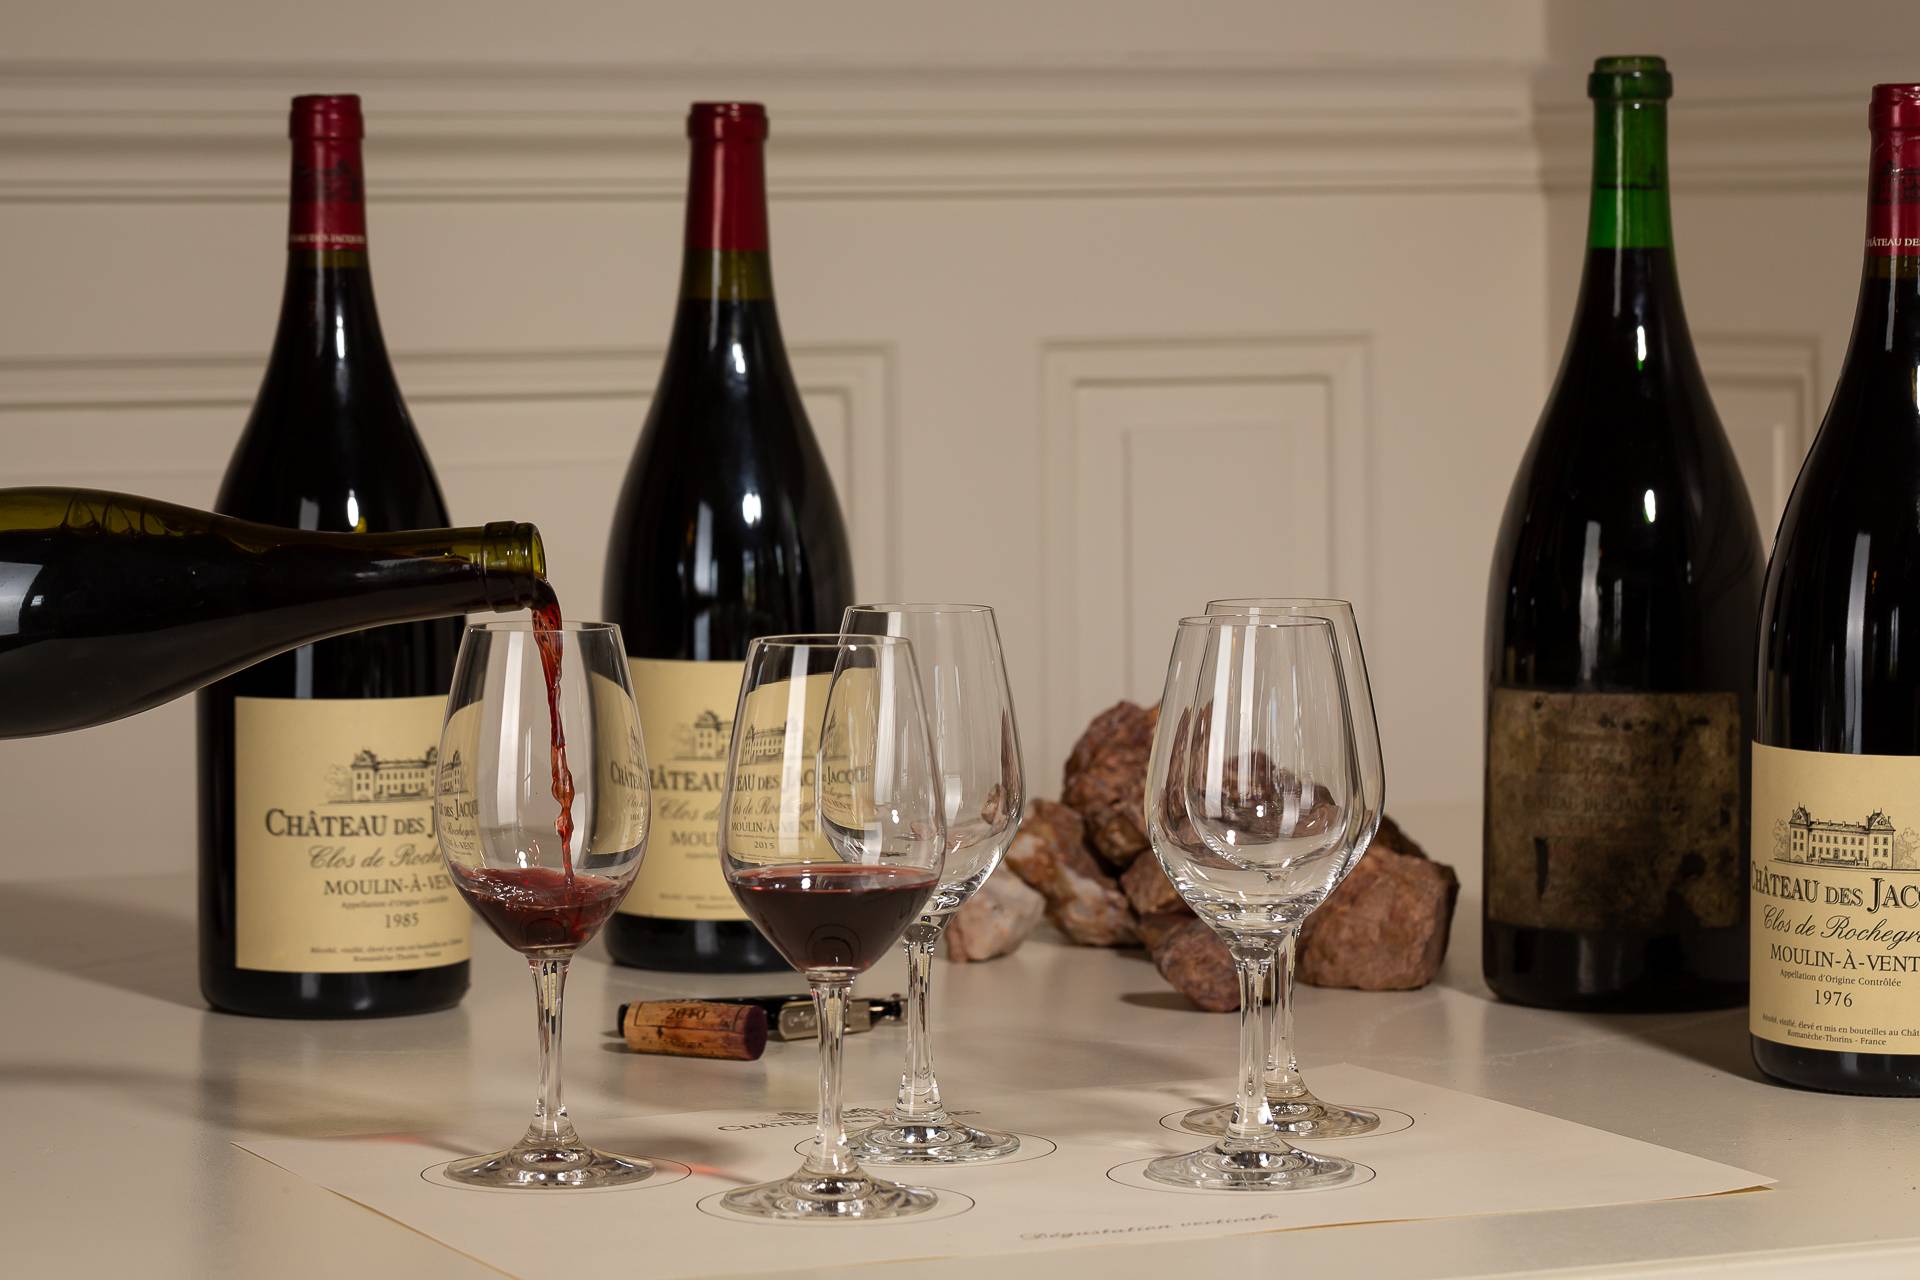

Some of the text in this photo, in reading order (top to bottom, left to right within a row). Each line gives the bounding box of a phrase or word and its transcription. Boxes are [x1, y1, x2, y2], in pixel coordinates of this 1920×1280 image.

[264, 807, 388, 837] CHÂTEAU
[393, 818, 425, 836] DES
[307, 845, 356, 869] Clos
[361, 846, 385, 868] de
[1751, 860, 1920, 914] CHÂTEAU DES JAC
[384, 911, 420, 929] 1985
[1763, 903, 1791, 934] Clos
[1794, 914, 1817, 937] de
[1770, 943, 1920, 973] MOULIN-À-VENT
[1779, 968, 1902, 988] Appellation d'Origine Contrôlée
[1814, 988, 1853, 1008] 1976
[1799, 1020, 1814, 1030] élevé
[1815, 1023, 1823, 1031] et
[1824, 1025, 1837, 1033] mis
[1850, 1027, 1887, 1037] bouteilles
[1860, 1037, 1887, 1047] France
